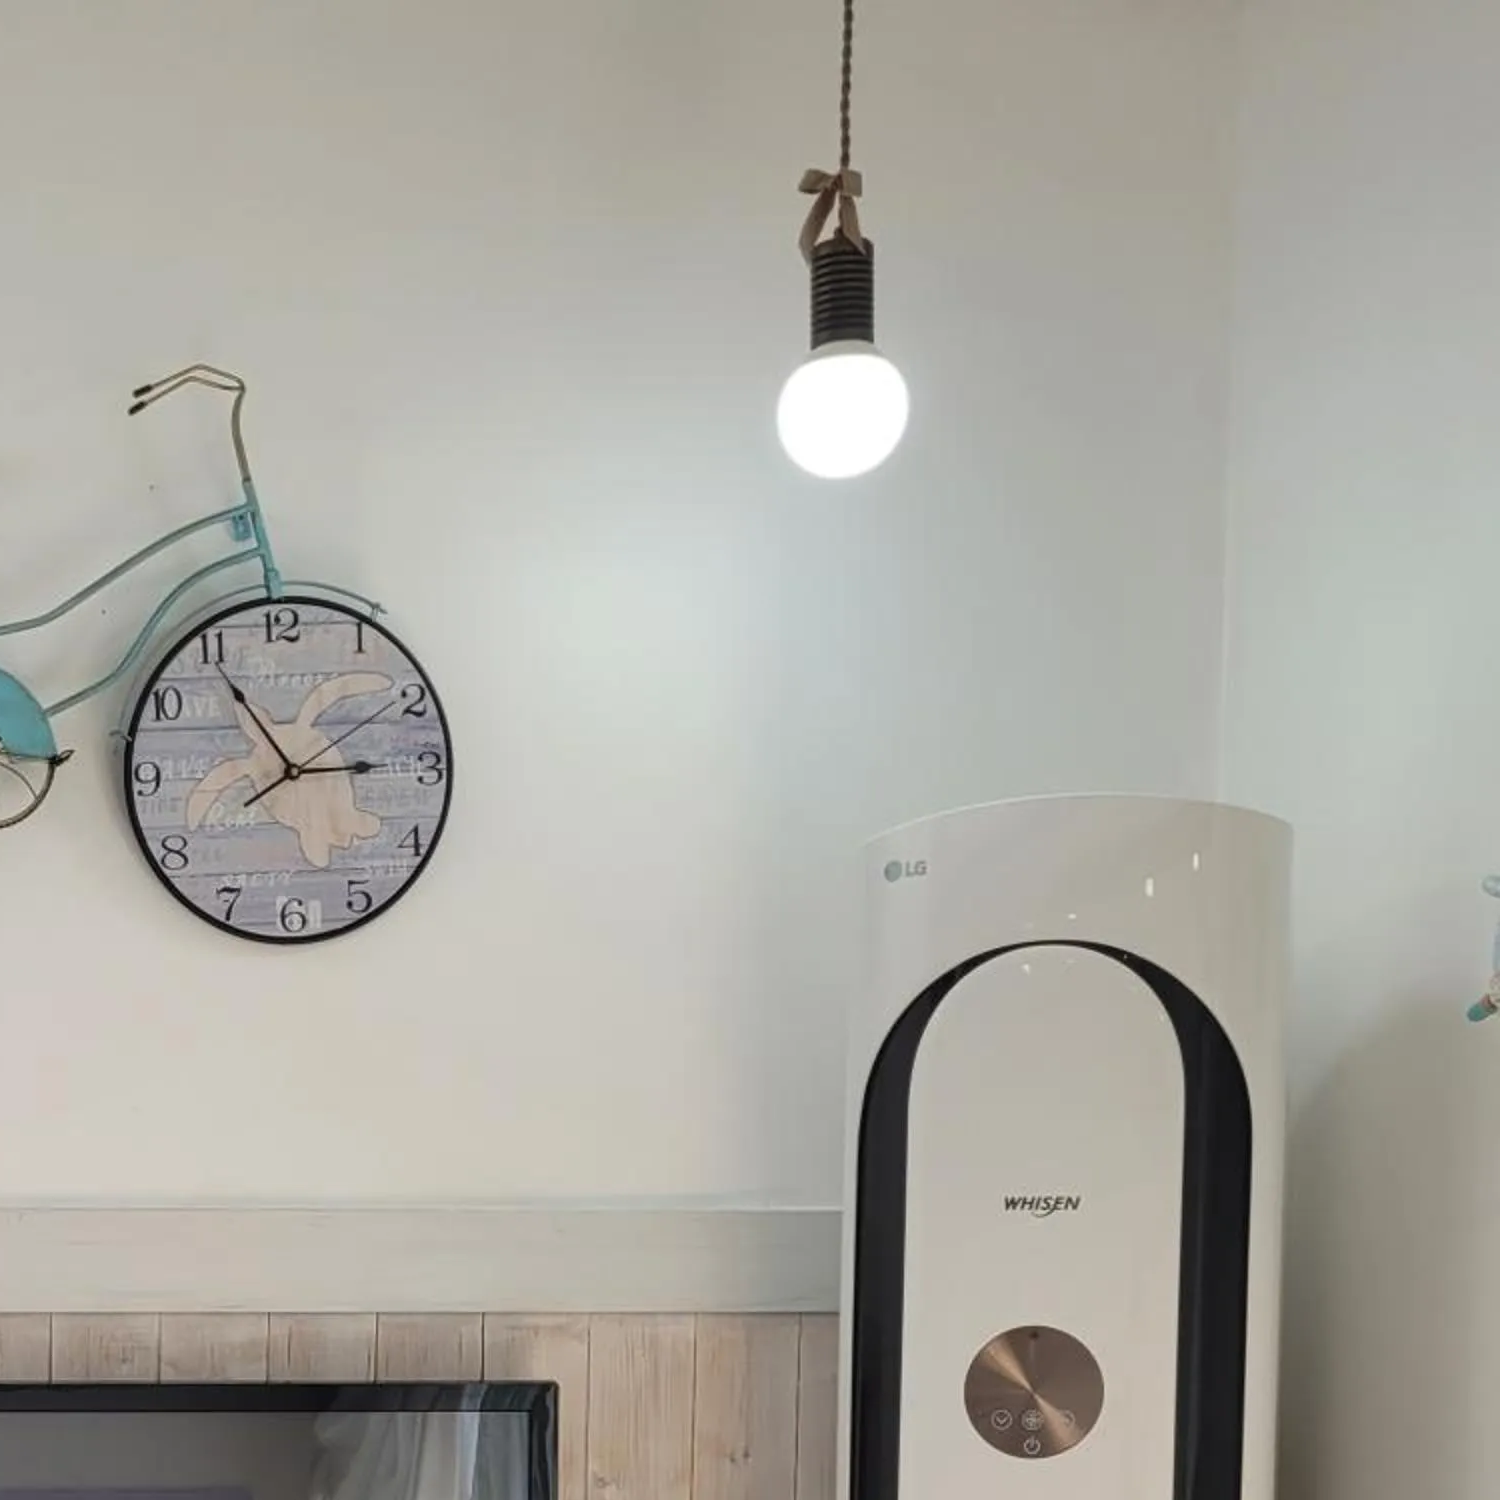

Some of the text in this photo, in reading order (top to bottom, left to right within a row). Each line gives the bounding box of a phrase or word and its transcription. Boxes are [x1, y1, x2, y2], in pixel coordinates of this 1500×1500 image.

[263, 607, 300, 642] 12
[353, 621, 366, 654] 1
[200, 630, 226, 665] 11
[152, 686, 183, 722] 10
[400, 683, 427, 718] 2
[134, 761, 161, 796] 9
[417, 751, 443, 786] 3
[160, 834, 189, 870] 8
[397, 824, 422, 857] 4
[905, 860, 927, 877] LG
[216, 885, 241, 921] 7
[346, 880, 372, 913] 5
[280, 897, 306, 932] 6
[1003, 1195, 1082, 1212] WHISEN
